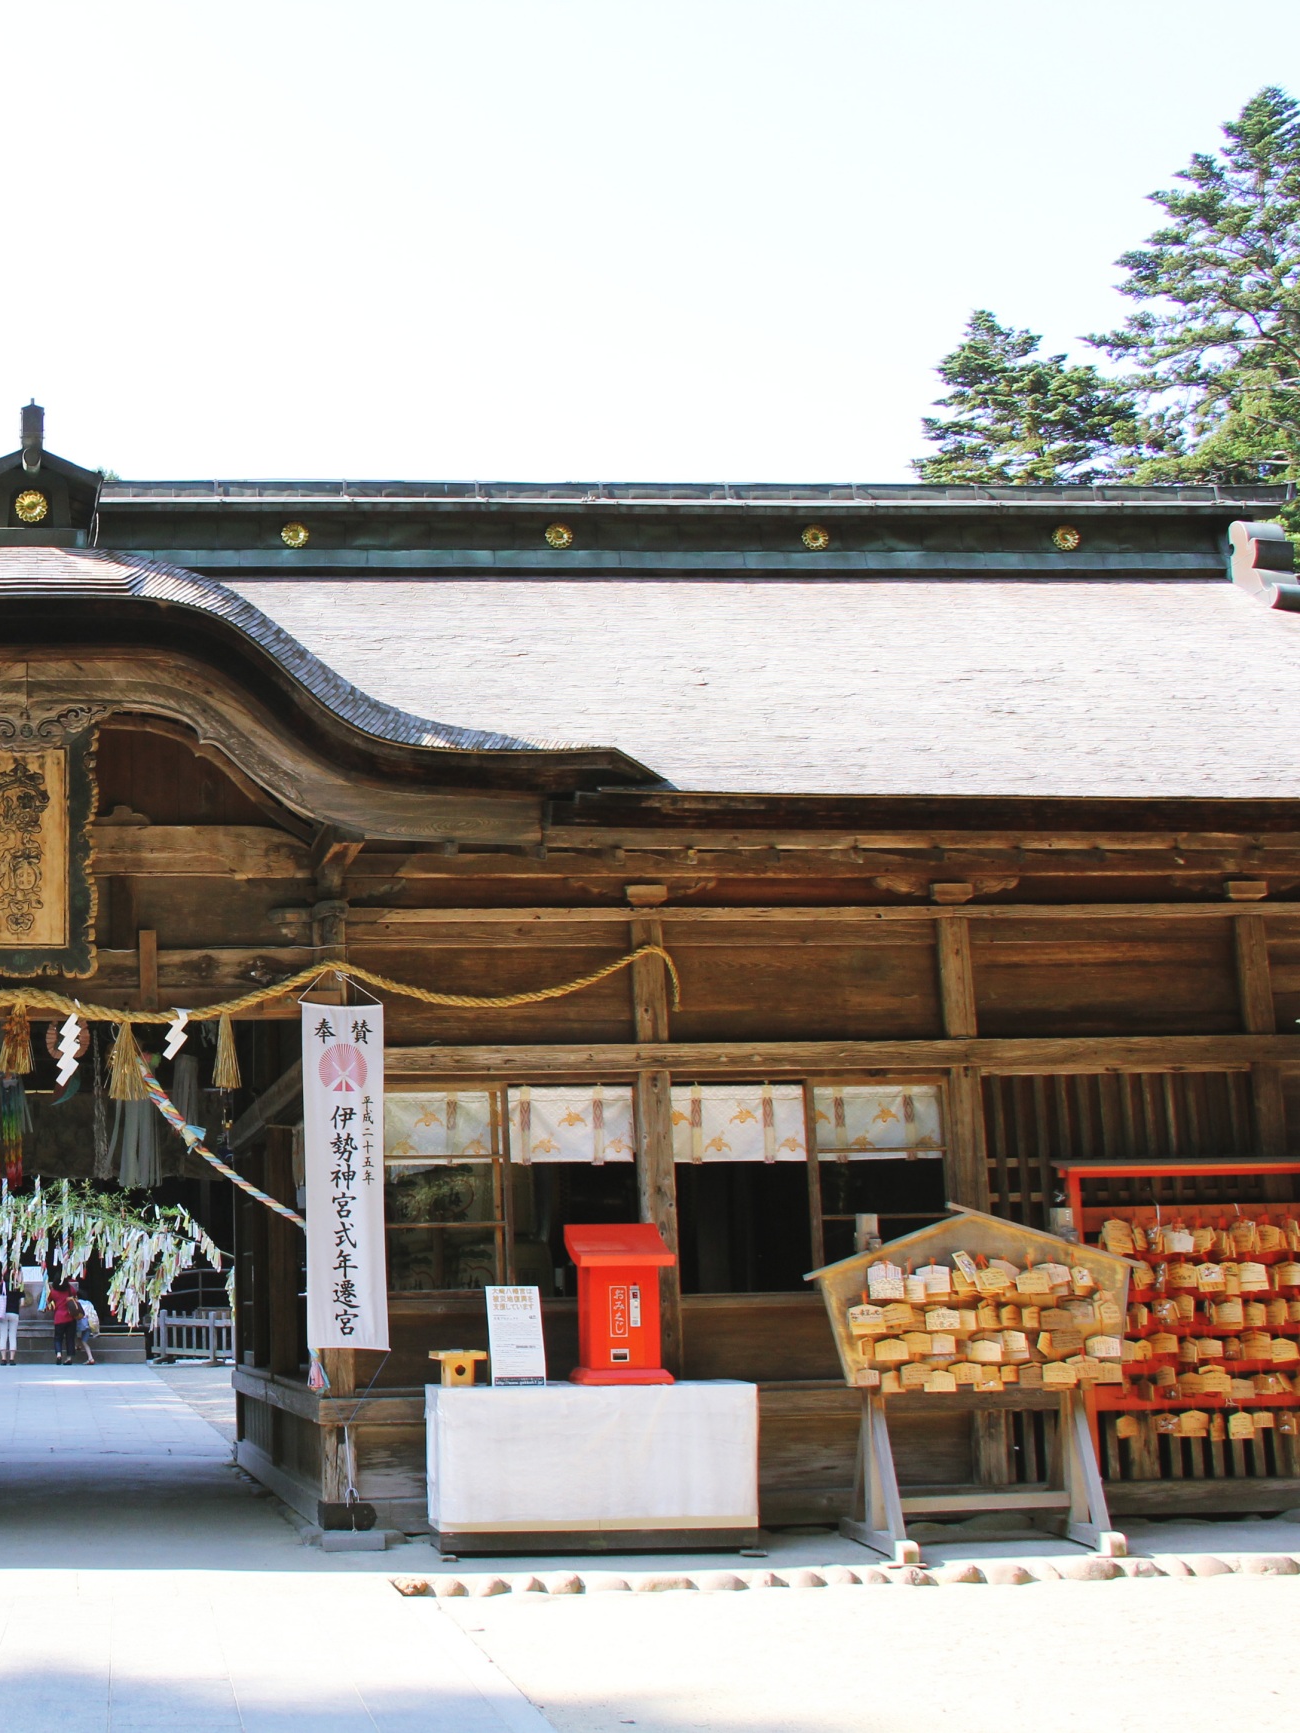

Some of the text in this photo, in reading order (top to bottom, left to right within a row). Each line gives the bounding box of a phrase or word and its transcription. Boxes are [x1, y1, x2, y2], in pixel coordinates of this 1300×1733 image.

[314, 1017, 373, 1044] 奉賛
[361, 1095, 375, 1187] 平成二十五年
[330, 1104, 360, 1336] 伊勢神宮式年遷宮
[613, 1289, 625, 1334] おみくじ
